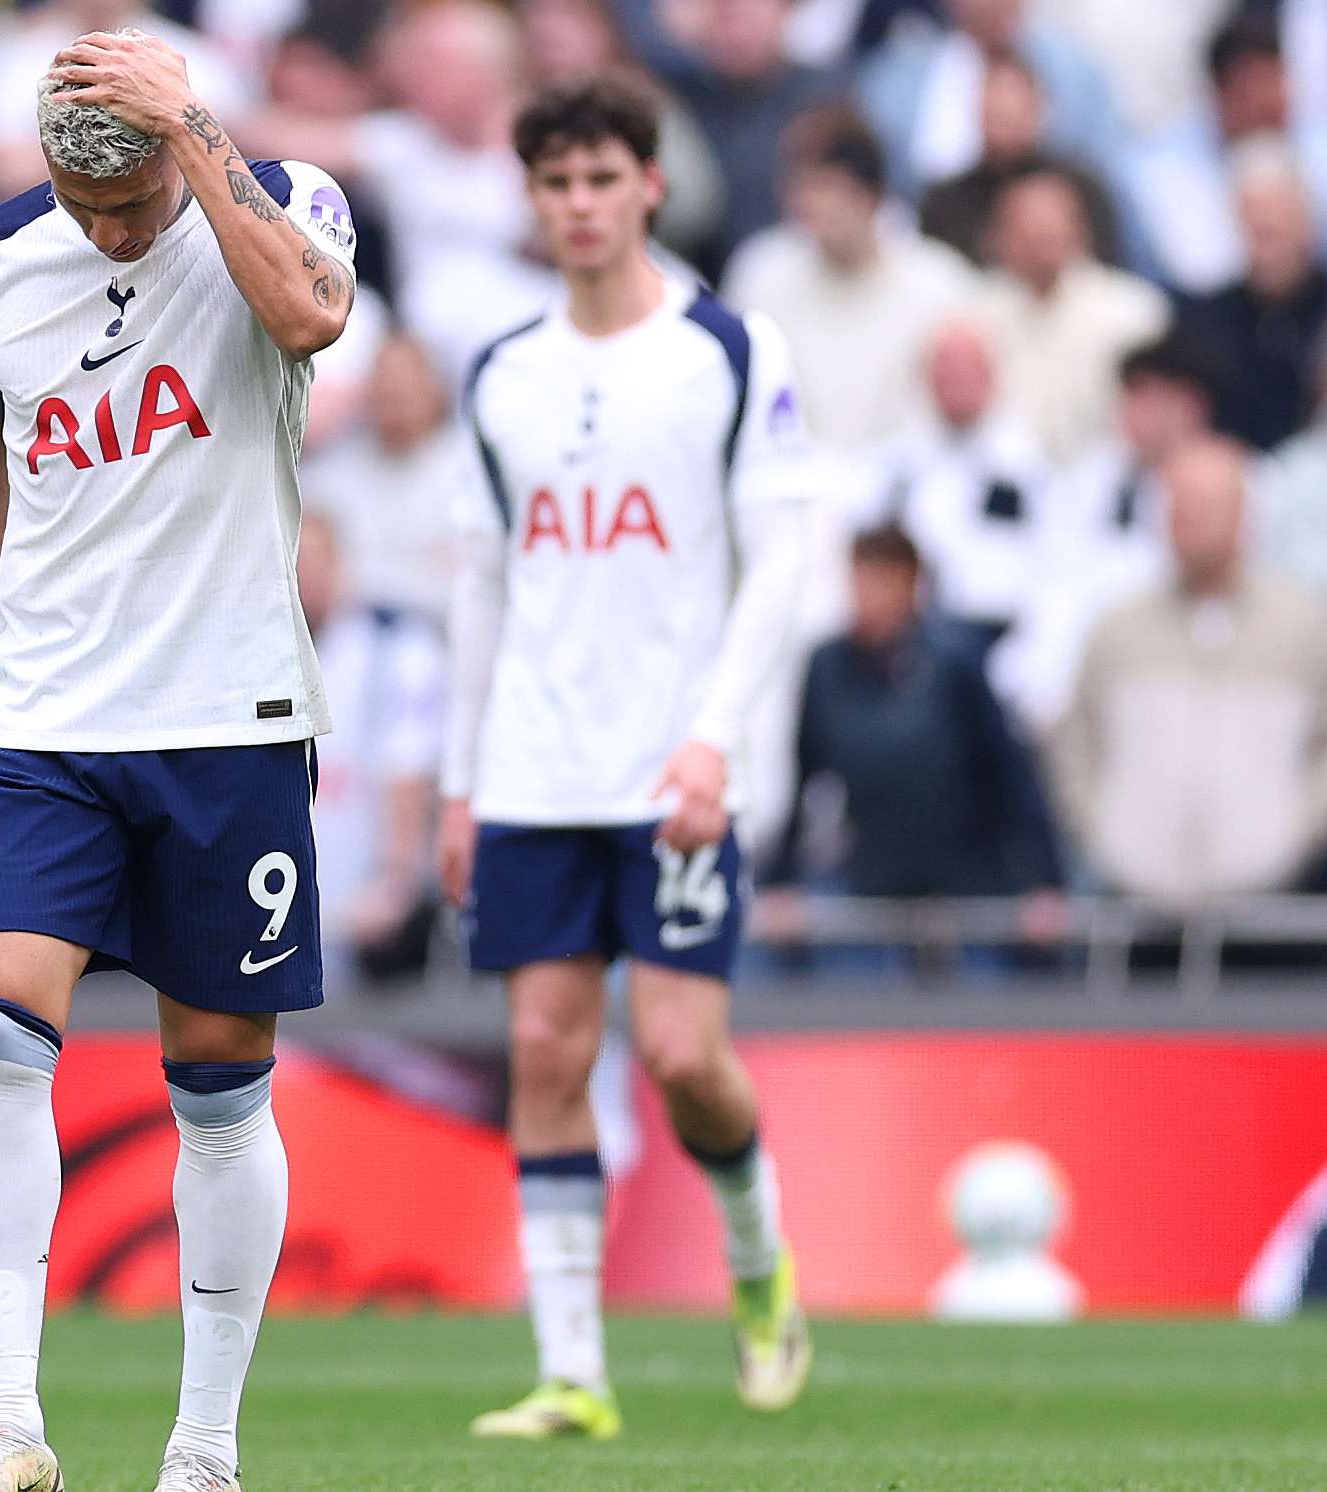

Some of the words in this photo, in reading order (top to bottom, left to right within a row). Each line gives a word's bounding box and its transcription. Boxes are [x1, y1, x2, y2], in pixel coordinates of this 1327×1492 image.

[26, 364, 212, 475] AIA
[522, 486, 670, 553] AIA
[248, 851, 298, 941] 9
